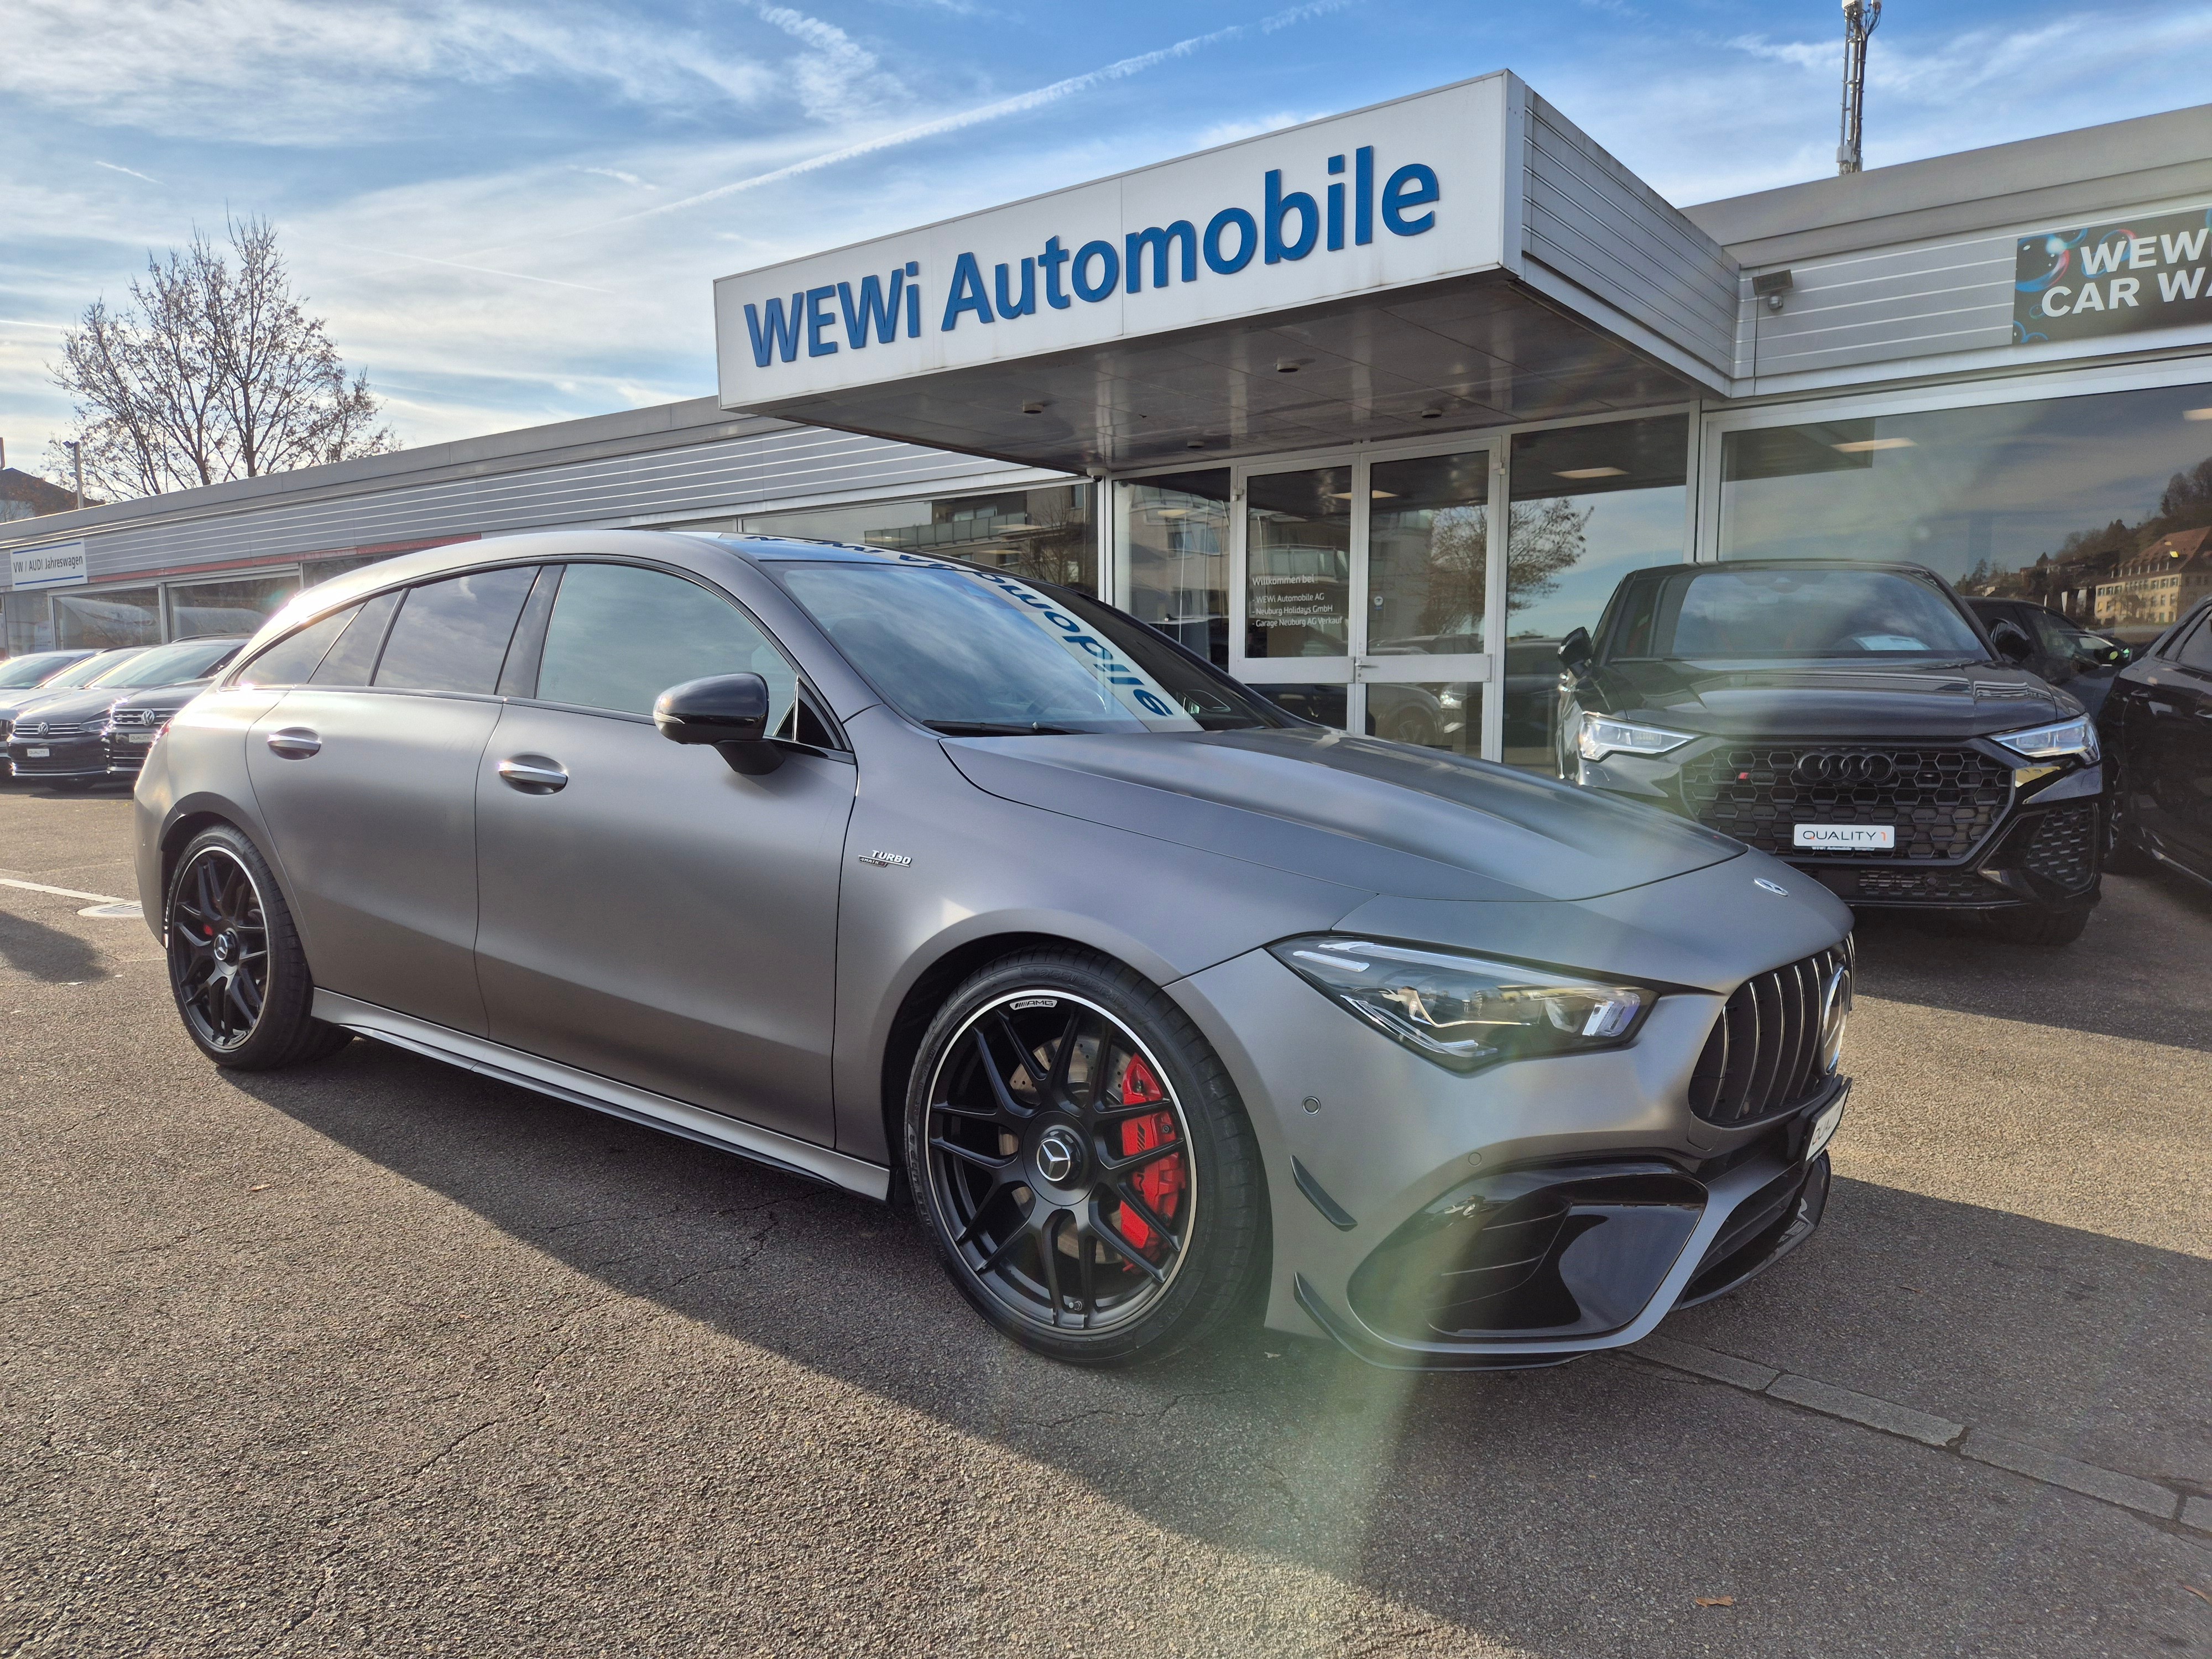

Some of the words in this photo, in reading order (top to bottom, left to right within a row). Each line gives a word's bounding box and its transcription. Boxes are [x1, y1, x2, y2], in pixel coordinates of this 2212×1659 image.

[743, 260, 921, 368] WEWi
[941, 145, 1439, 332] Automobile
[2080, 228, 2212, 275] WEW
[2042, 278, 2141, 317] CAR
[2157, 267, 2212, 302] W
[13, 561, 23, 573] VW
[29, 559, 43, 571] AUDI
[45, 555, 83, 570] Jahreswagen
[1252, 577, 1300, 586] Willkommen
[1302, 574, 1314, 583] bei
[1256, 594, 1276, 603] WEWi
[1277, 593, 1313, 602] Automobile
[1315, 592, 1324, 601] AG
[1256, 607, 1283, 617] Neuburg
[1284, 606, 1311, 615] Holidays
[1312, 605, 1333, 613] GmbH
[1256, 619, 1278, 628] Garage
[1279, 618, 1306, 627] Neuburg
[1307, 617, 1317, 625] AG
[1318, 616, 1343, 625] Verkauf
[1803, 831, 1876, 841] QUALITY
[872, 850, 912, 864] TURBO
